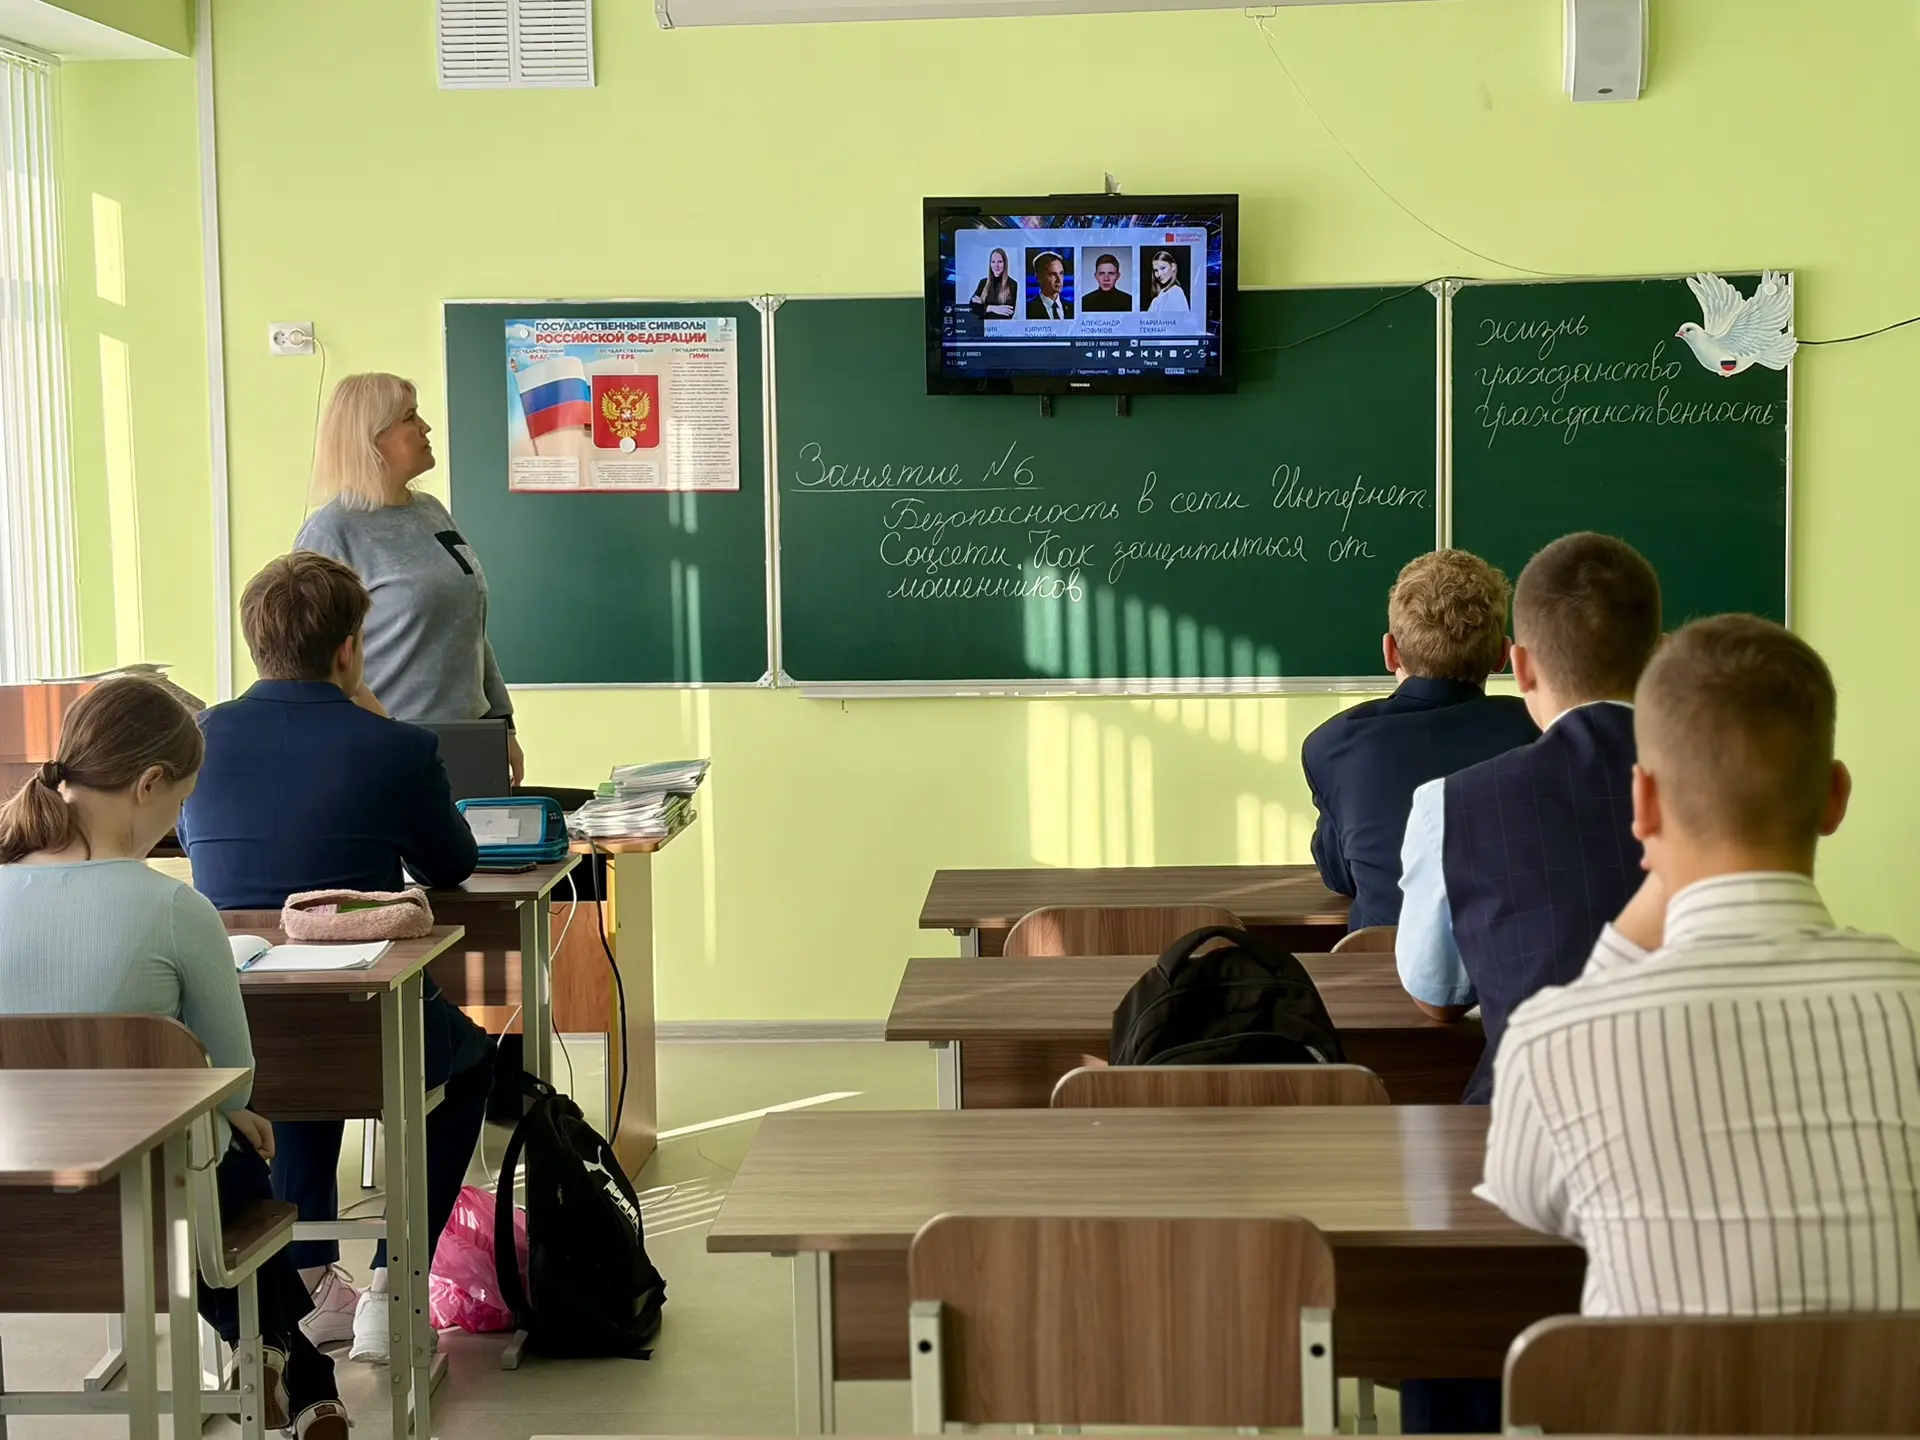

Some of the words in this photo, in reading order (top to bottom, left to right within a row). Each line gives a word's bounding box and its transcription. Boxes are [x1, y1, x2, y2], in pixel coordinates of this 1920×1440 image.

[535, 321, 647, 332] ГОСУДАРСТВЕННЫЕ
[648, 321, 706, 330] СИМВОЛЫ
[535, 331, 625, 344] РОССИЙСКОЙ
[627, 332, 707, 344] ФЕДЕРАЦИИ
[1475, 314, 1590, 362] жизнь
[1474, 340, 1683, 406] гражданство
[1474, 385, 1774, 449] гражданственность
[795, 442, 963, 488] Занятие
[883, 497, 1120, 546] Безопасность
[1136, 470, 1158, 515] в
[1169, 490, 1251, 514] сети
[1028, 529, 1095, 569] Как
[1107, 535, 1308, 585] защититься
[1327, 535, 1376, 563] от
[886, 566, 1084, 603] мошенников
